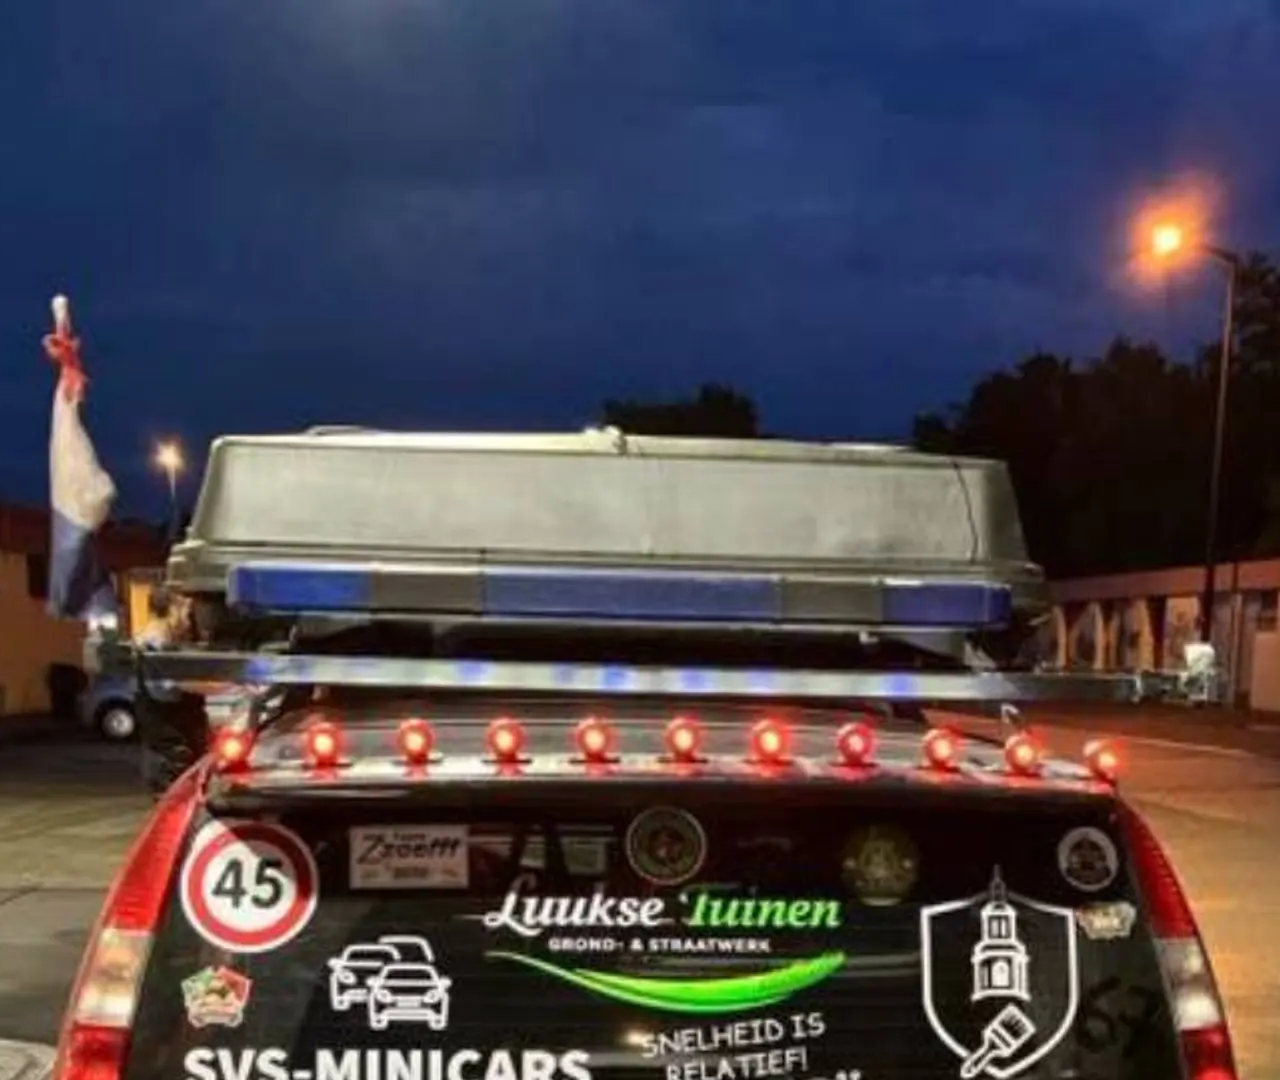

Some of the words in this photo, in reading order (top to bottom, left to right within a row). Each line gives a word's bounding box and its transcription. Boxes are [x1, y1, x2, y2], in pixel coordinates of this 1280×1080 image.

[212, 857, 285, 909] 45
[483, 876, 665, 936] Luukse
[678, 884, 841, 927] Tuinen
[630, 938, 642, 951] &
[649, 938, 771, 953] STRAATWERK
[641, 1019, 784, 1058] SNELHEID
[790, 1012, 826, 1039] IS
